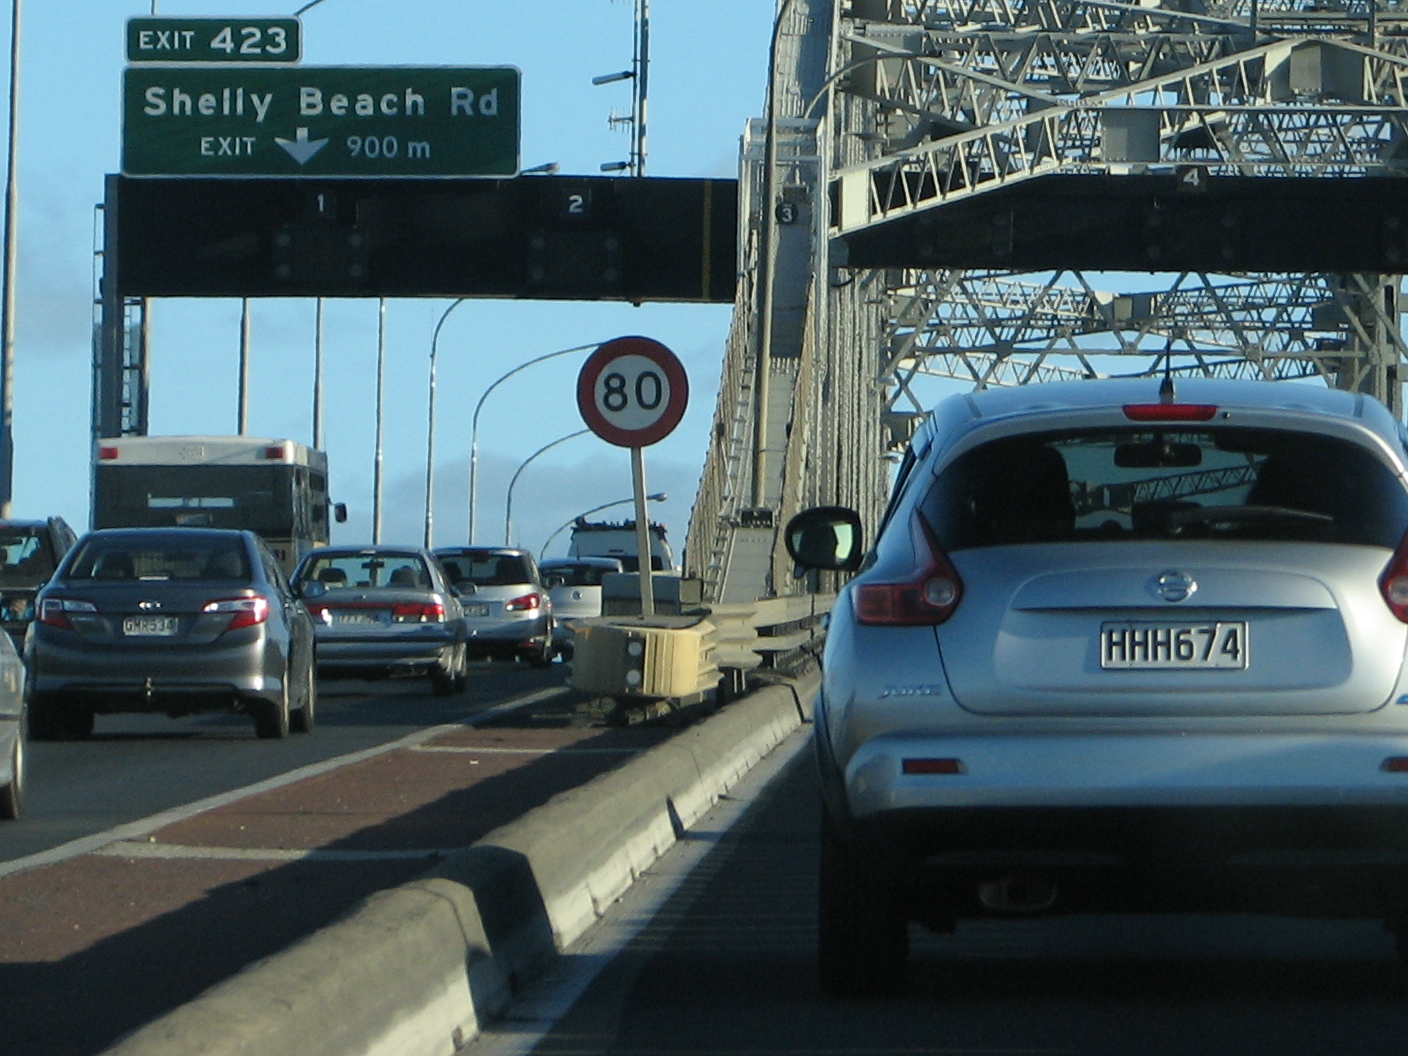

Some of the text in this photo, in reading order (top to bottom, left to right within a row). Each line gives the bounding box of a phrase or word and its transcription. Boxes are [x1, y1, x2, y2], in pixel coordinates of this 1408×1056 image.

[138, 26, 287, 55] EXIT 423
[143, 85, 499, 123] Shelly Beach Rd
[199, 135, 431, 159] EXIT 900 m
[1183, 167, 1200, 186] 4
[316, 194, 325, 213] 1
[567, 194, 584, 214] 2
[781, 207, 793, 223] 3
[602, 370, 663, 413] 80
[1107, 628, 1240, 662] HHH674
